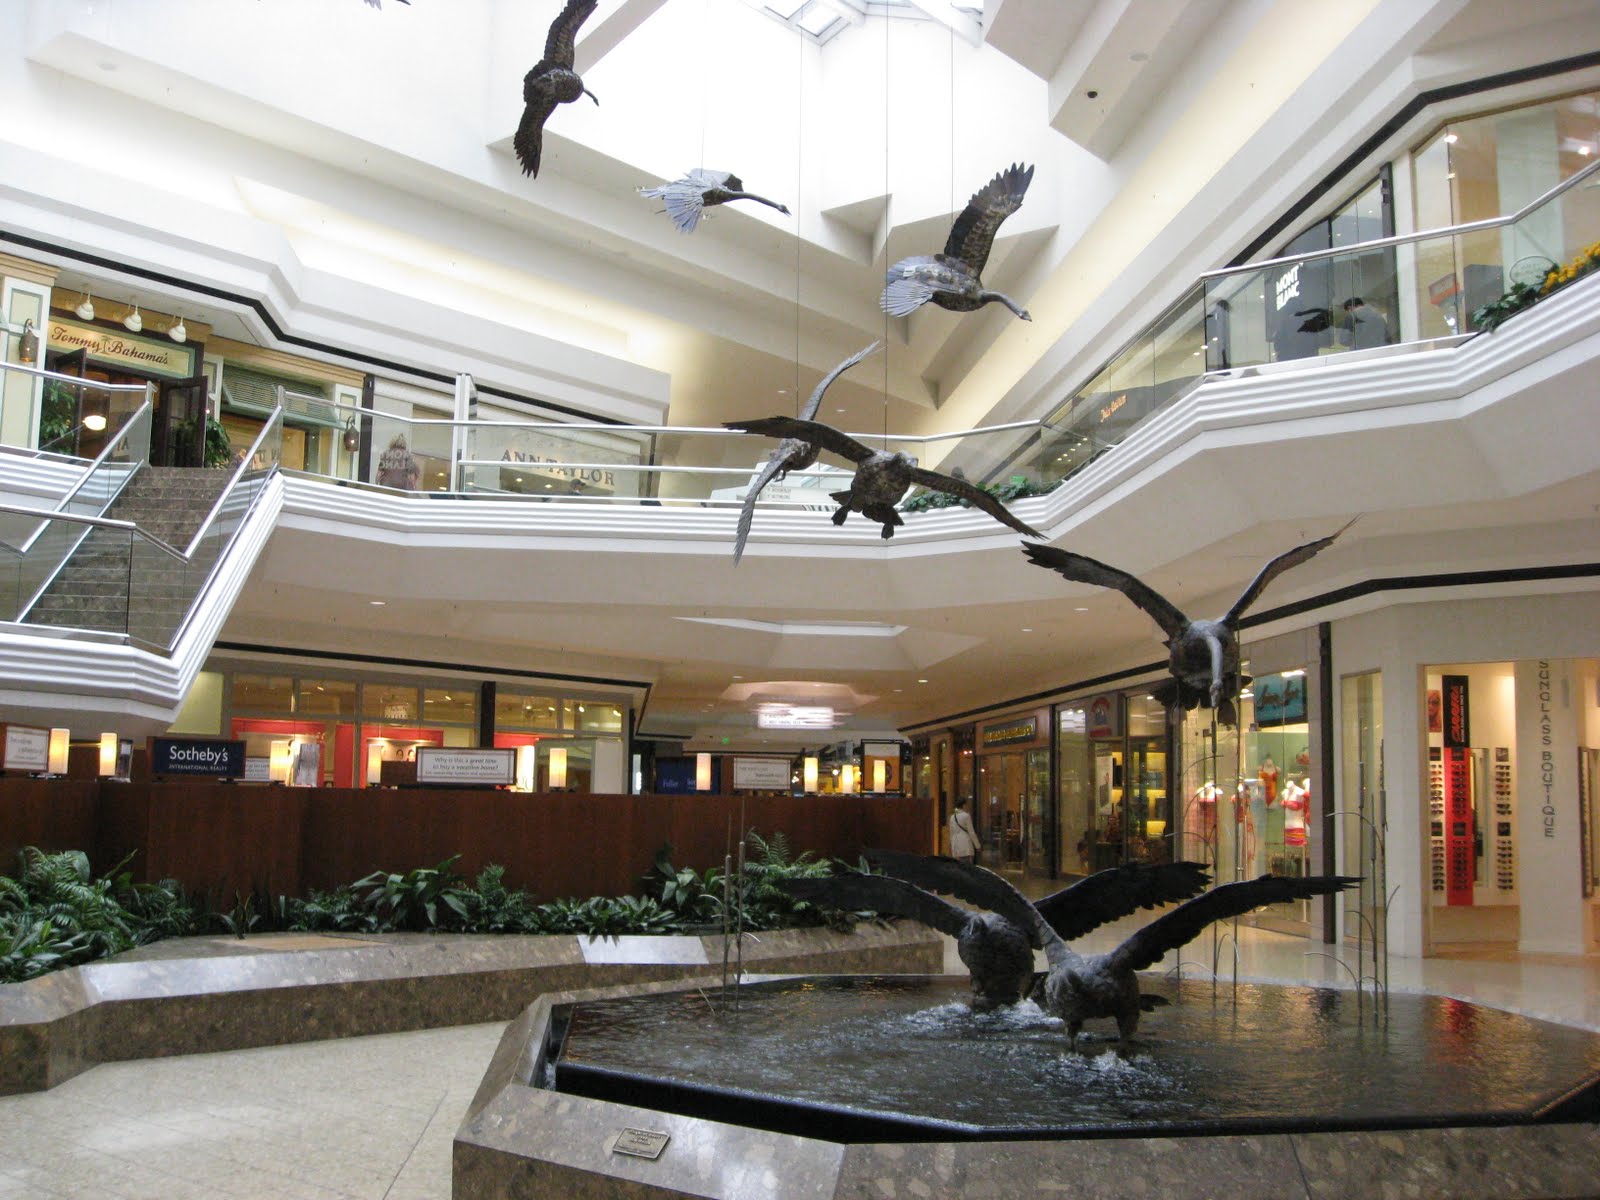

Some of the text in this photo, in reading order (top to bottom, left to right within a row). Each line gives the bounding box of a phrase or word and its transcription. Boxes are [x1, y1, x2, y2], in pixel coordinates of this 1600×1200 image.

[1276, 264, 1299, 296] MONT
[1276, 280, 1299, 311] BLANC
[51, 326, 168, 365] Tommy Bahama's
[501, 449, 615, 486] ANN TAYLOR
[170, 746, 228, 765] Sotheby's
[1541, 751, 1555, 838] BOUTIQUE
